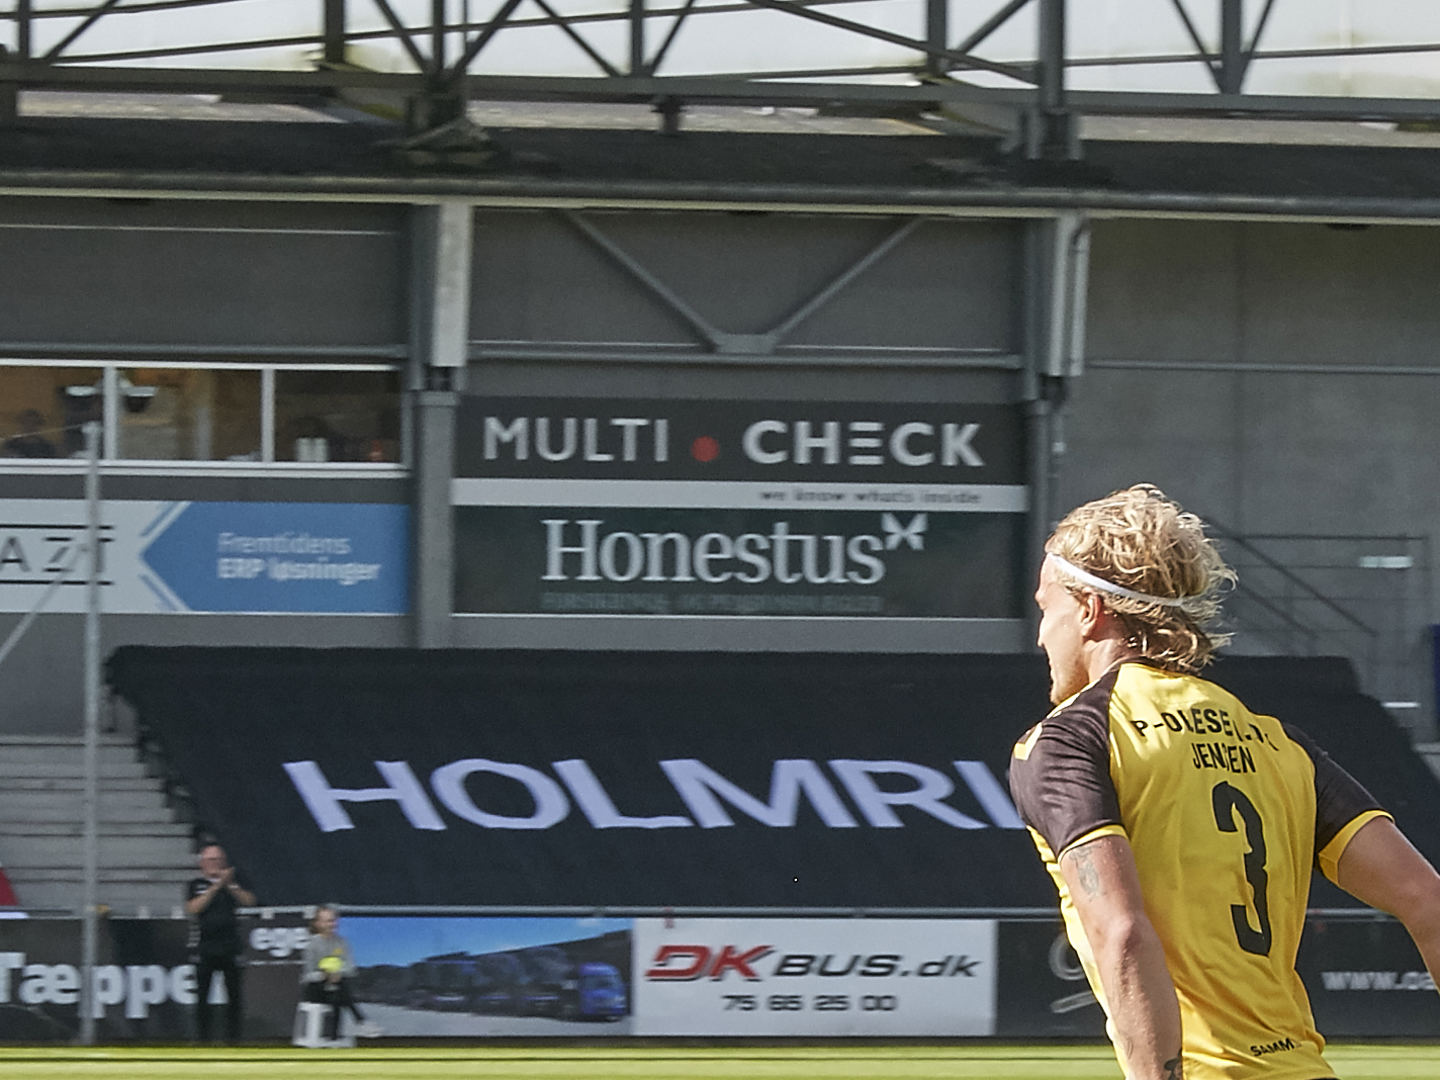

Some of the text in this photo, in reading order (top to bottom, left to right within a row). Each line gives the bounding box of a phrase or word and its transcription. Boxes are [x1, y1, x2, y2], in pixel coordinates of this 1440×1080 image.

[483, 416, 985, 467] MULTI CHECK
[217, 557, 265, 579] ERP
[541, 518, 888, 584] Honestus
[1211, 781, 1272, 957] 3
[722, 994, 758, 1011] 75
[858, 994, 898, 1011] 00
